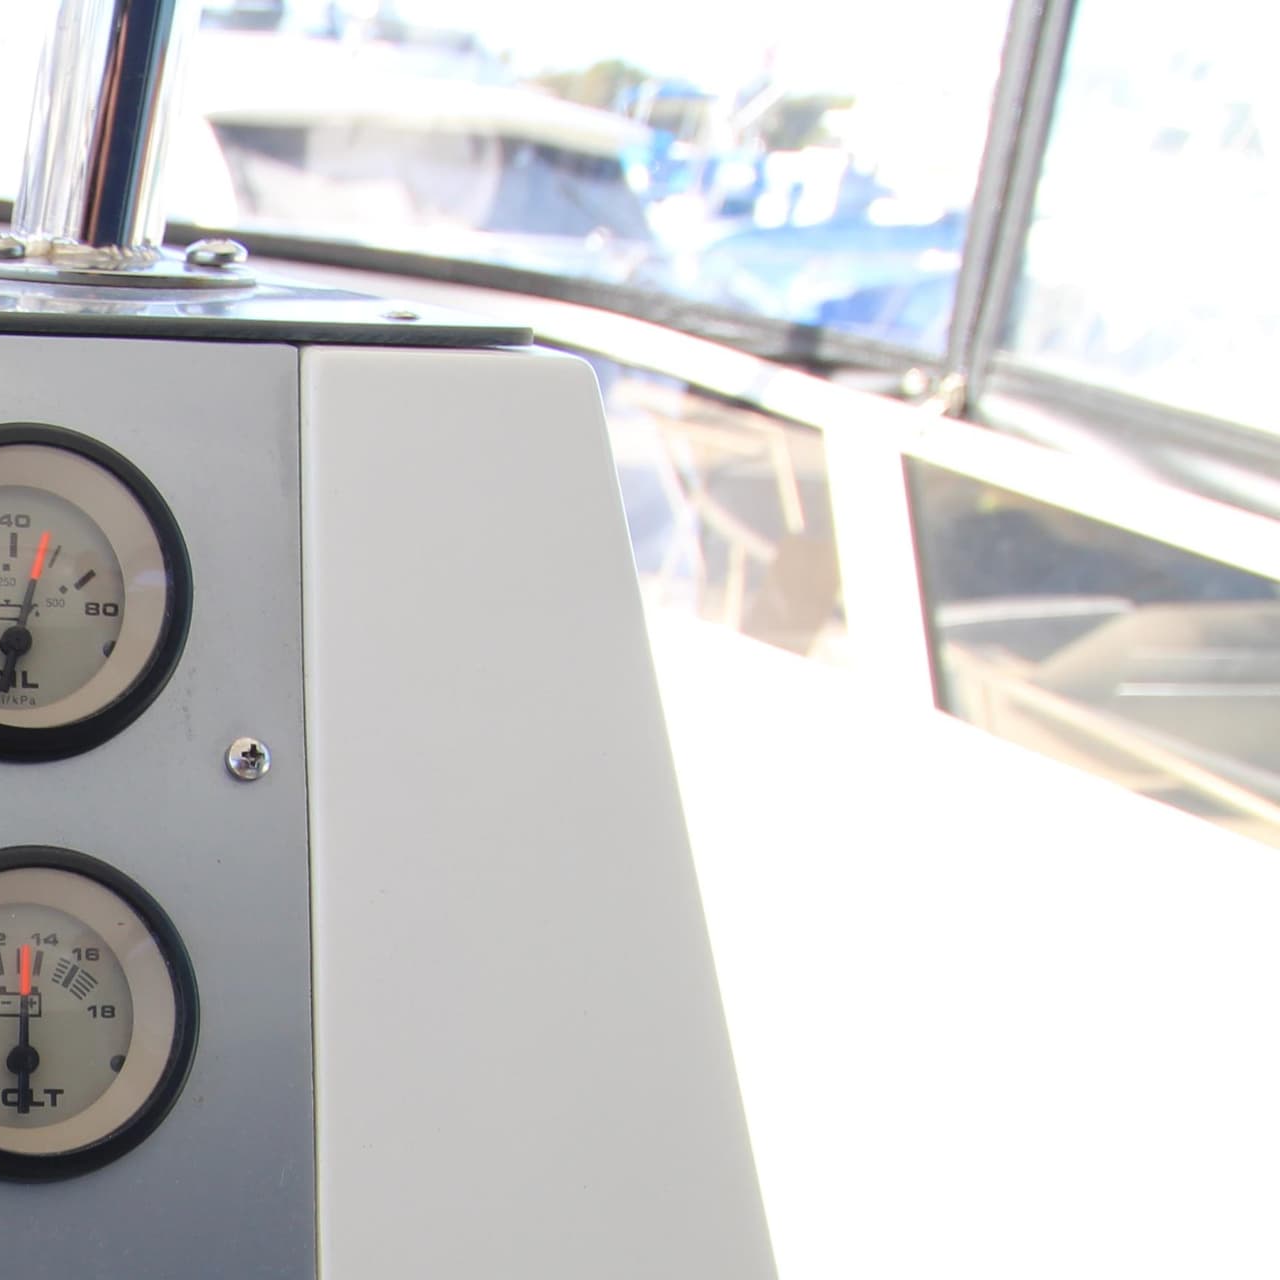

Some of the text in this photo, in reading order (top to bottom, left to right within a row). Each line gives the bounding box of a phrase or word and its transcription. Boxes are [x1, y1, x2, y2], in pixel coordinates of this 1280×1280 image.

[46, 598, 65, 608] 500
[85, 603, 119, 617] 80
[31, 933, 59, 947] 14
[72, 948, 100, 961] 16
[87, 1005, 116, 1019] 18
